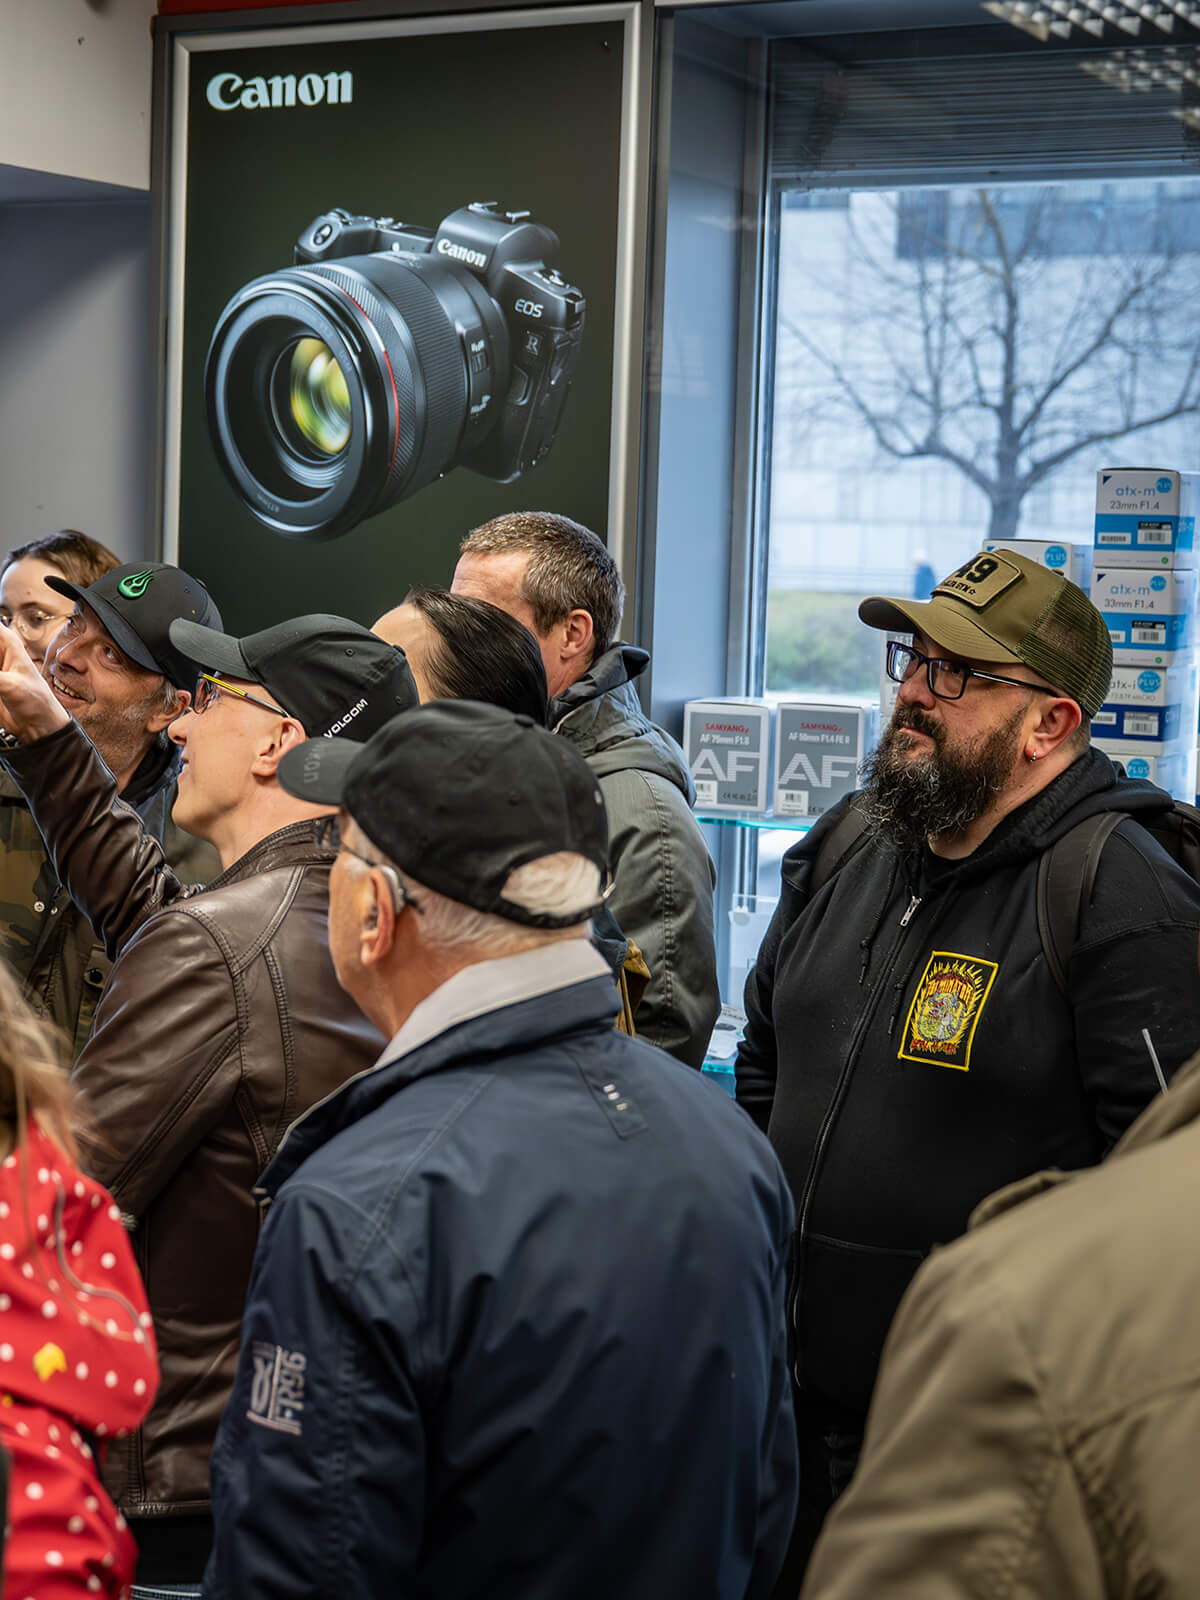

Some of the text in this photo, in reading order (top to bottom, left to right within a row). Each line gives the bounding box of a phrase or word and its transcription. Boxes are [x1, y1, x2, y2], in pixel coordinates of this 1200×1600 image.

[206, 71, 353, 111] Canon
[437, 238, 487, 268] Canon
[514, 298, 545, 318] EOS
[527, 335, 539, 355] R
[1115, 485, 1156, 497] atx-m
[1109, 500, 1160, 511] 23mm F1.4
[1109, 584, 1151, 596] atx-m
[1103, 598, 1155, 609] 33mm F1.4
[1139, 679, 1161, 688] PLUS
[323, 698, 369, 739] VOLCOM
[704, 722, 745, 733] SAMYANG
[801, 721, 840, 732] SAMYANG
[699, 732, 711, 744] AF
[788, 731, 798, 741] AF
[690, 748, 761, 783] AF
[777, 752, 858, 788] AF
